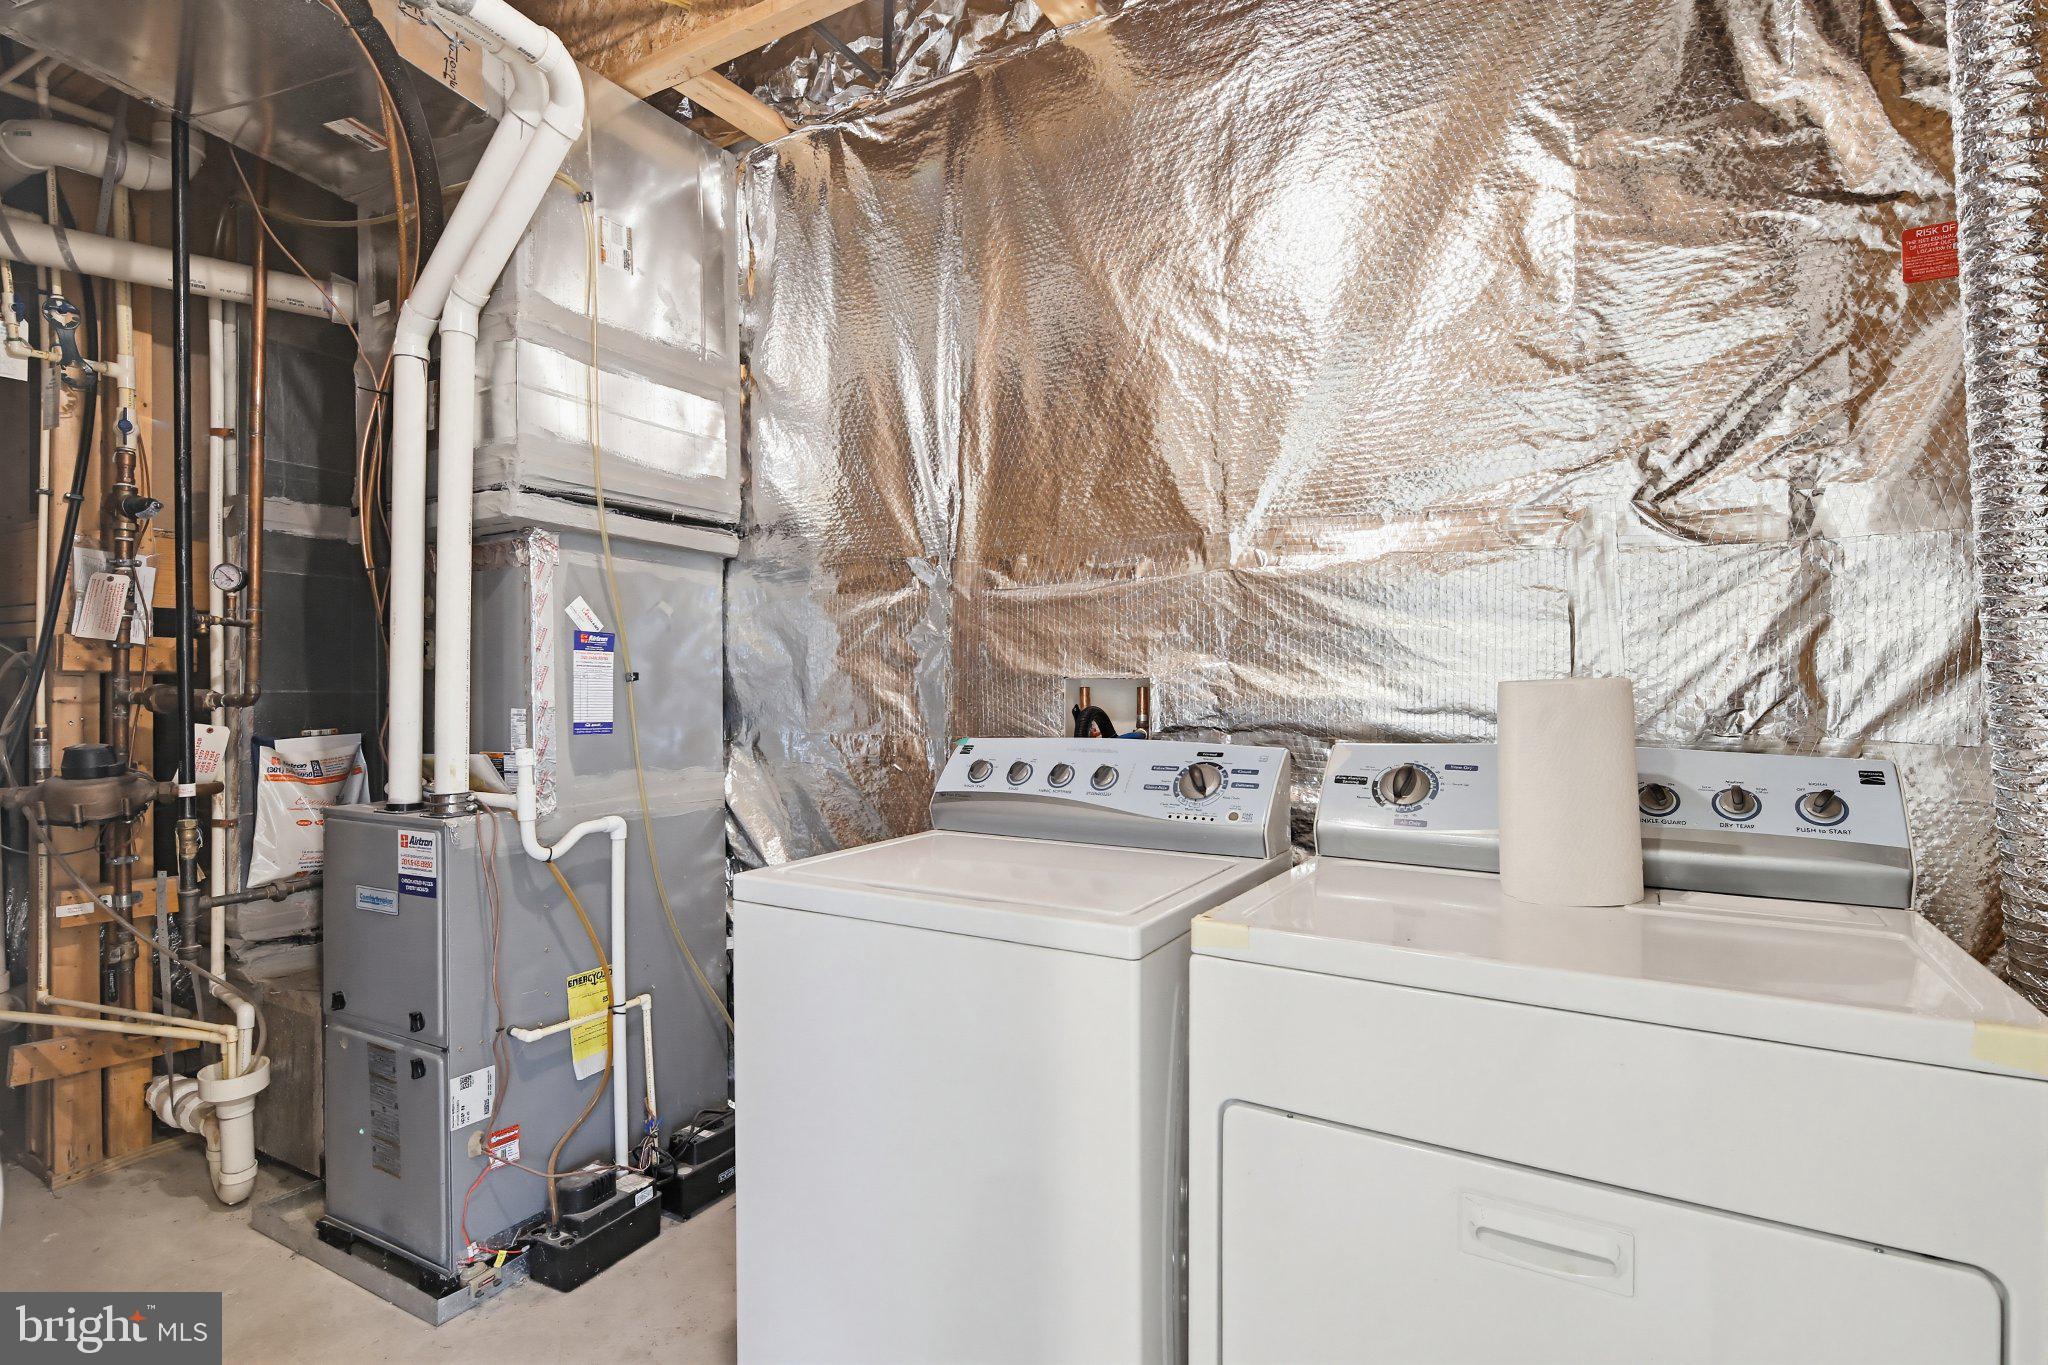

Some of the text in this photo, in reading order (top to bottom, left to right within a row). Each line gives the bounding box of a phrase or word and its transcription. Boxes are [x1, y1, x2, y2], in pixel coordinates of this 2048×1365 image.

[1915, 223, 1957, 238] RISK OF
[409, 835, 433, 847] Airtron
